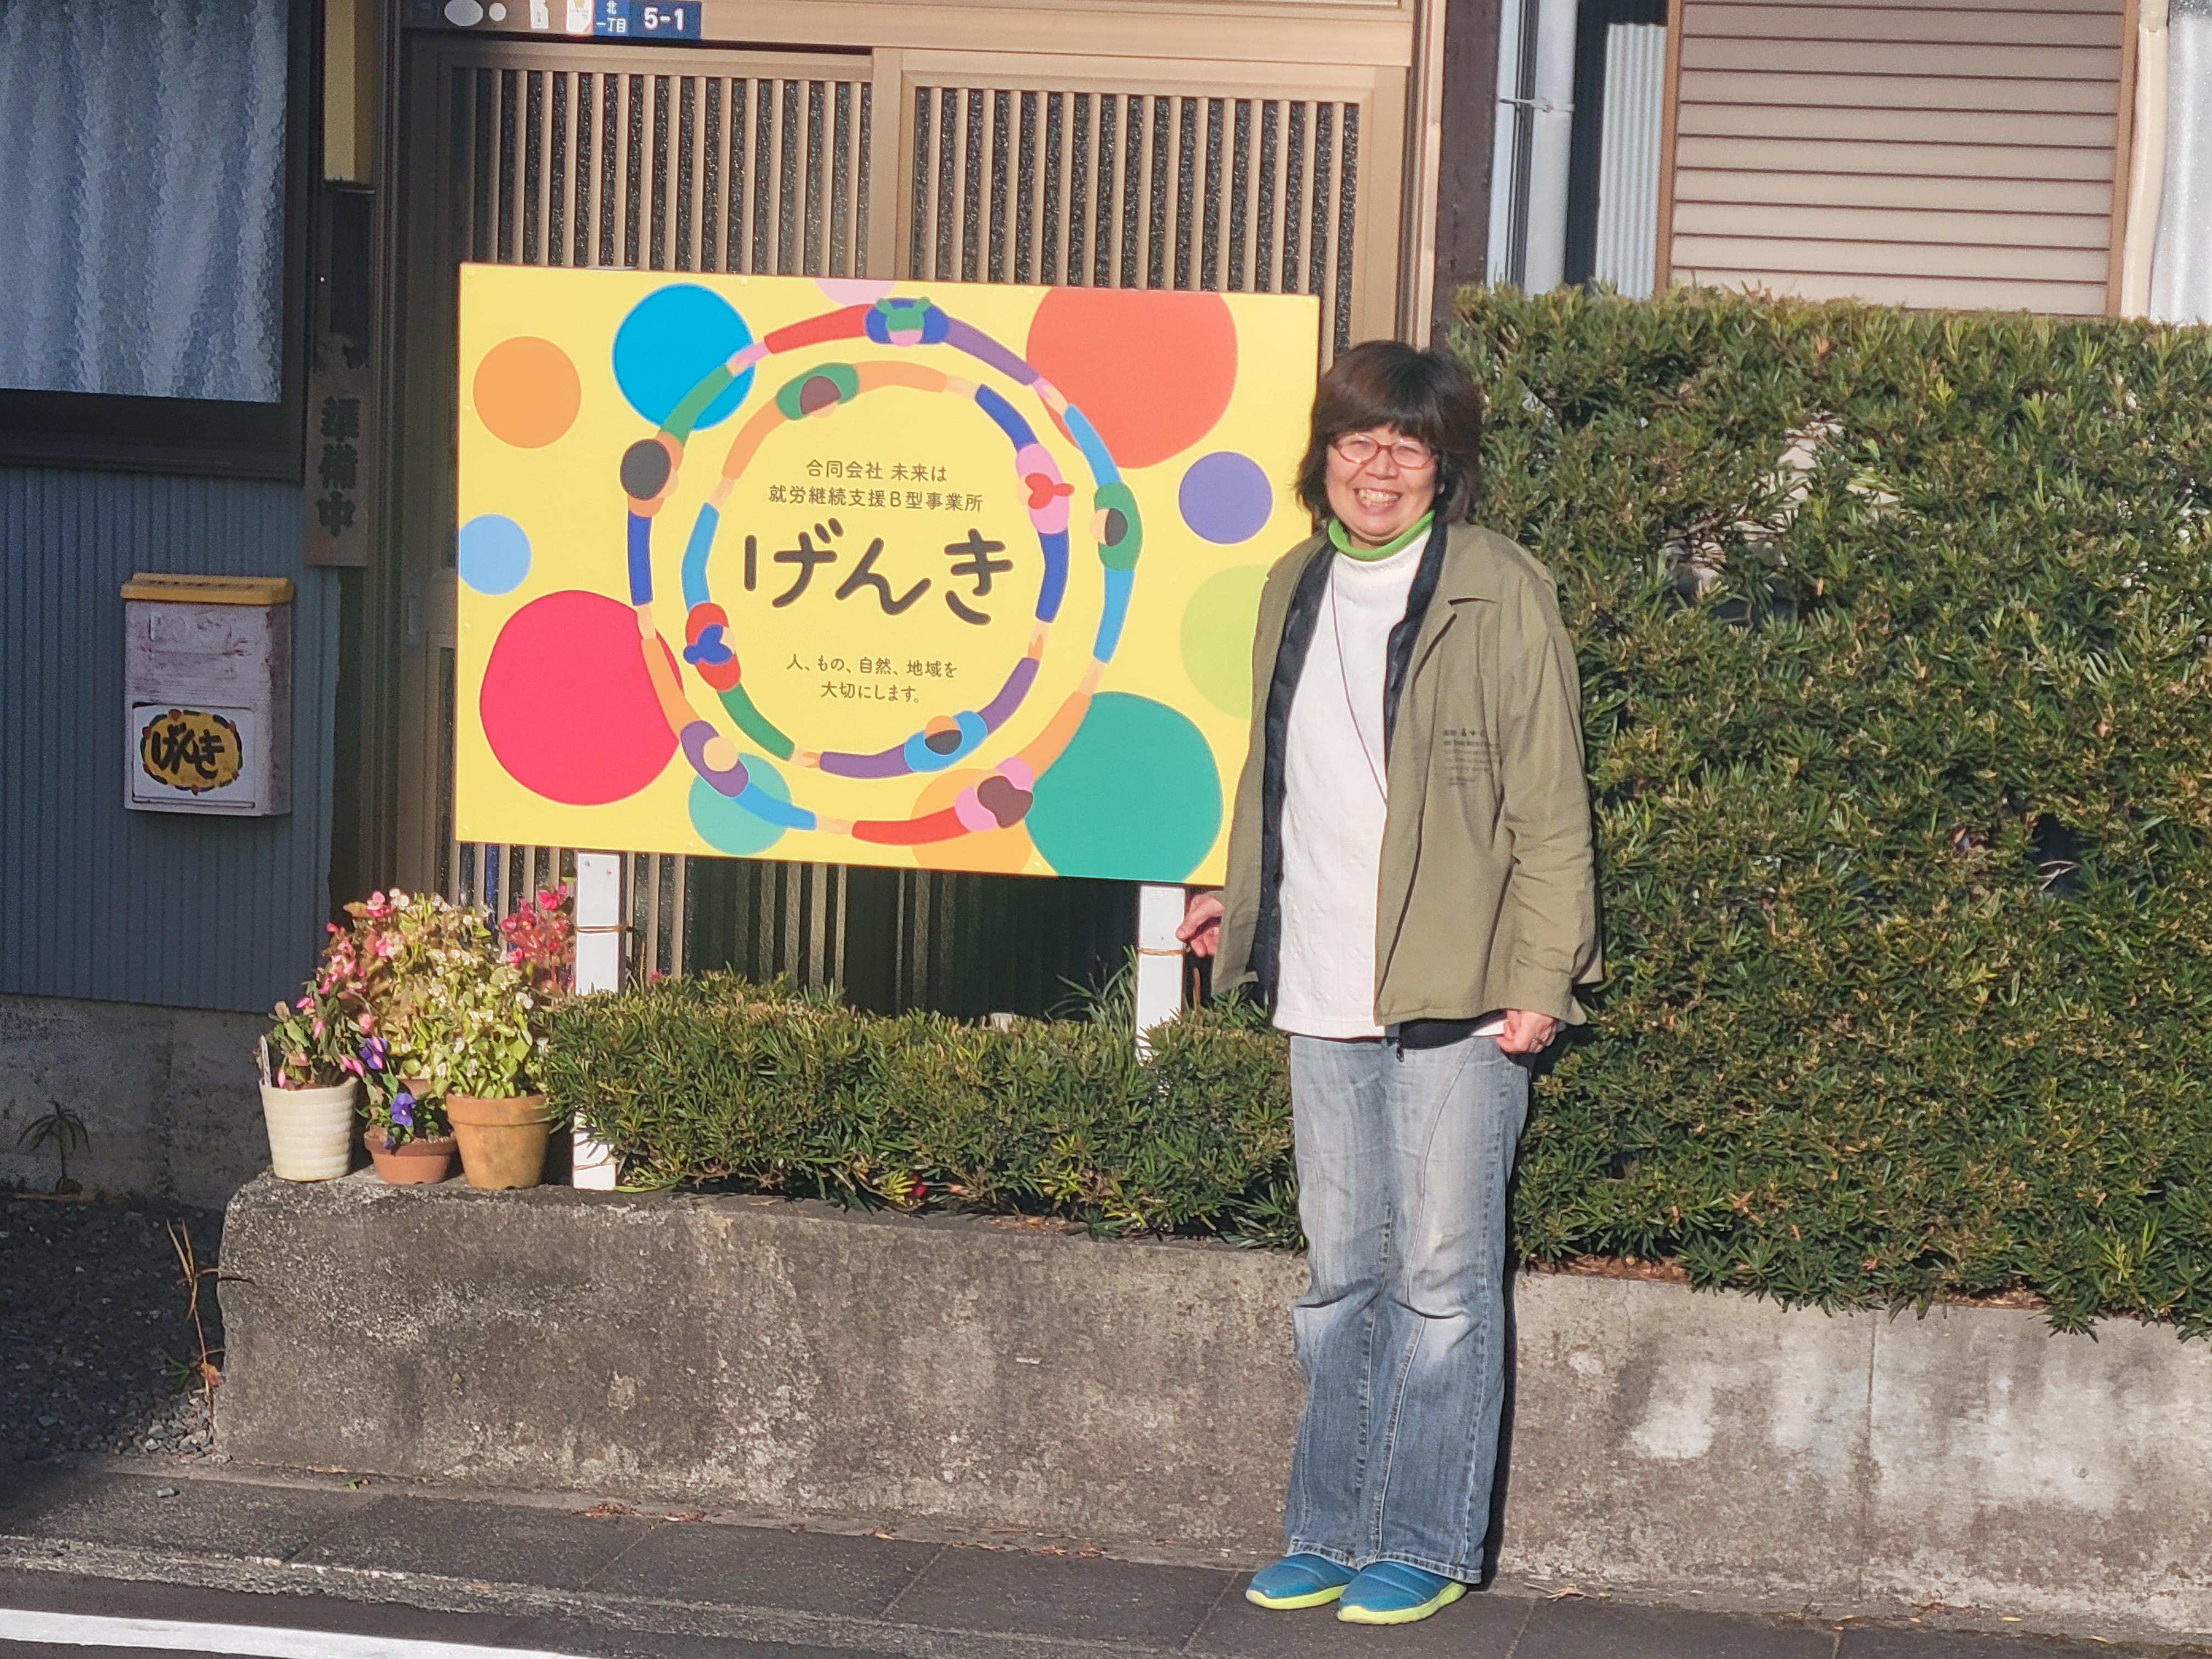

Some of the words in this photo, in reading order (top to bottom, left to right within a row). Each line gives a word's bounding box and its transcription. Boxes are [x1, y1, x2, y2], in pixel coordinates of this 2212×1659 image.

[596, 18, 627, 33] 一丁目
[644, 7, 684, 31] 5-1
[806, 459, 883, 479] 合同会社
[891, 462, 947, 482] 未来は
[769, 484, 983, 512] 就労継続支援B型事業所
[744, 517, 1014, 625] げんき
[787, 653, 957, 678] 人、もの、自然、地域を
[820, 681, 919, 704] 大切にします。
[151, 722, 224, 779] げんき
